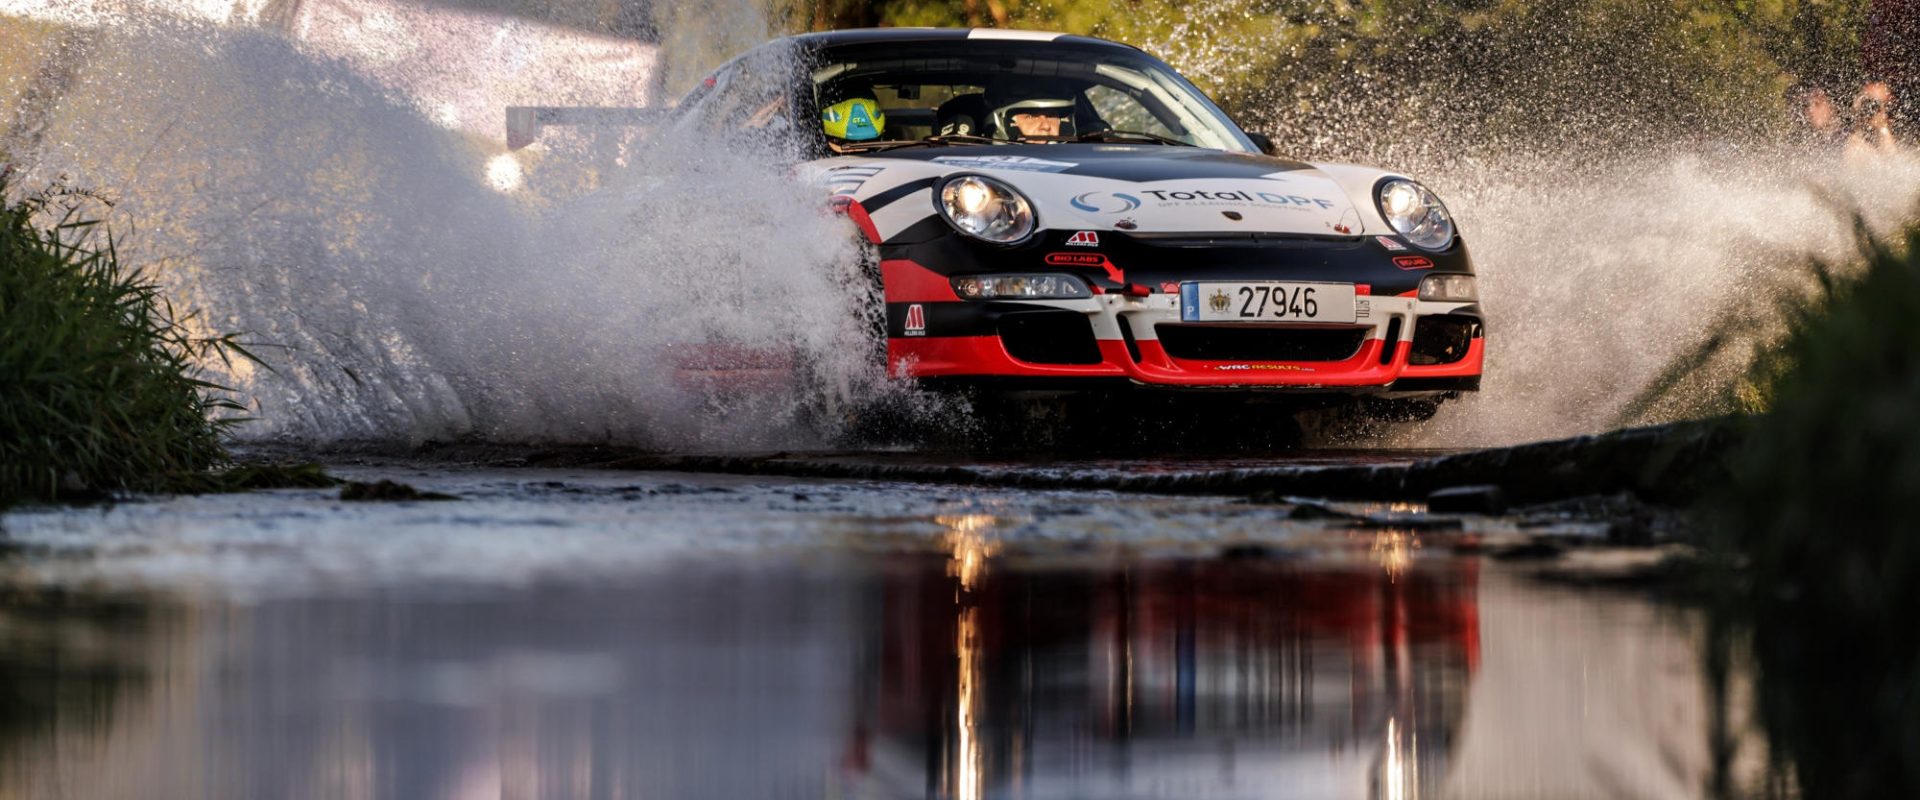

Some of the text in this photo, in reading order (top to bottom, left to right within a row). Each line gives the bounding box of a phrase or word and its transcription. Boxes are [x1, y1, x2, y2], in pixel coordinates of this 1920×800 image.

[1141, 189, 1334, 209] Total DPF
[1073, 255, 1099, 263] LABS
[1238, 286, 1318, 318] 27946
[1187, 306, 1195, 316] P
